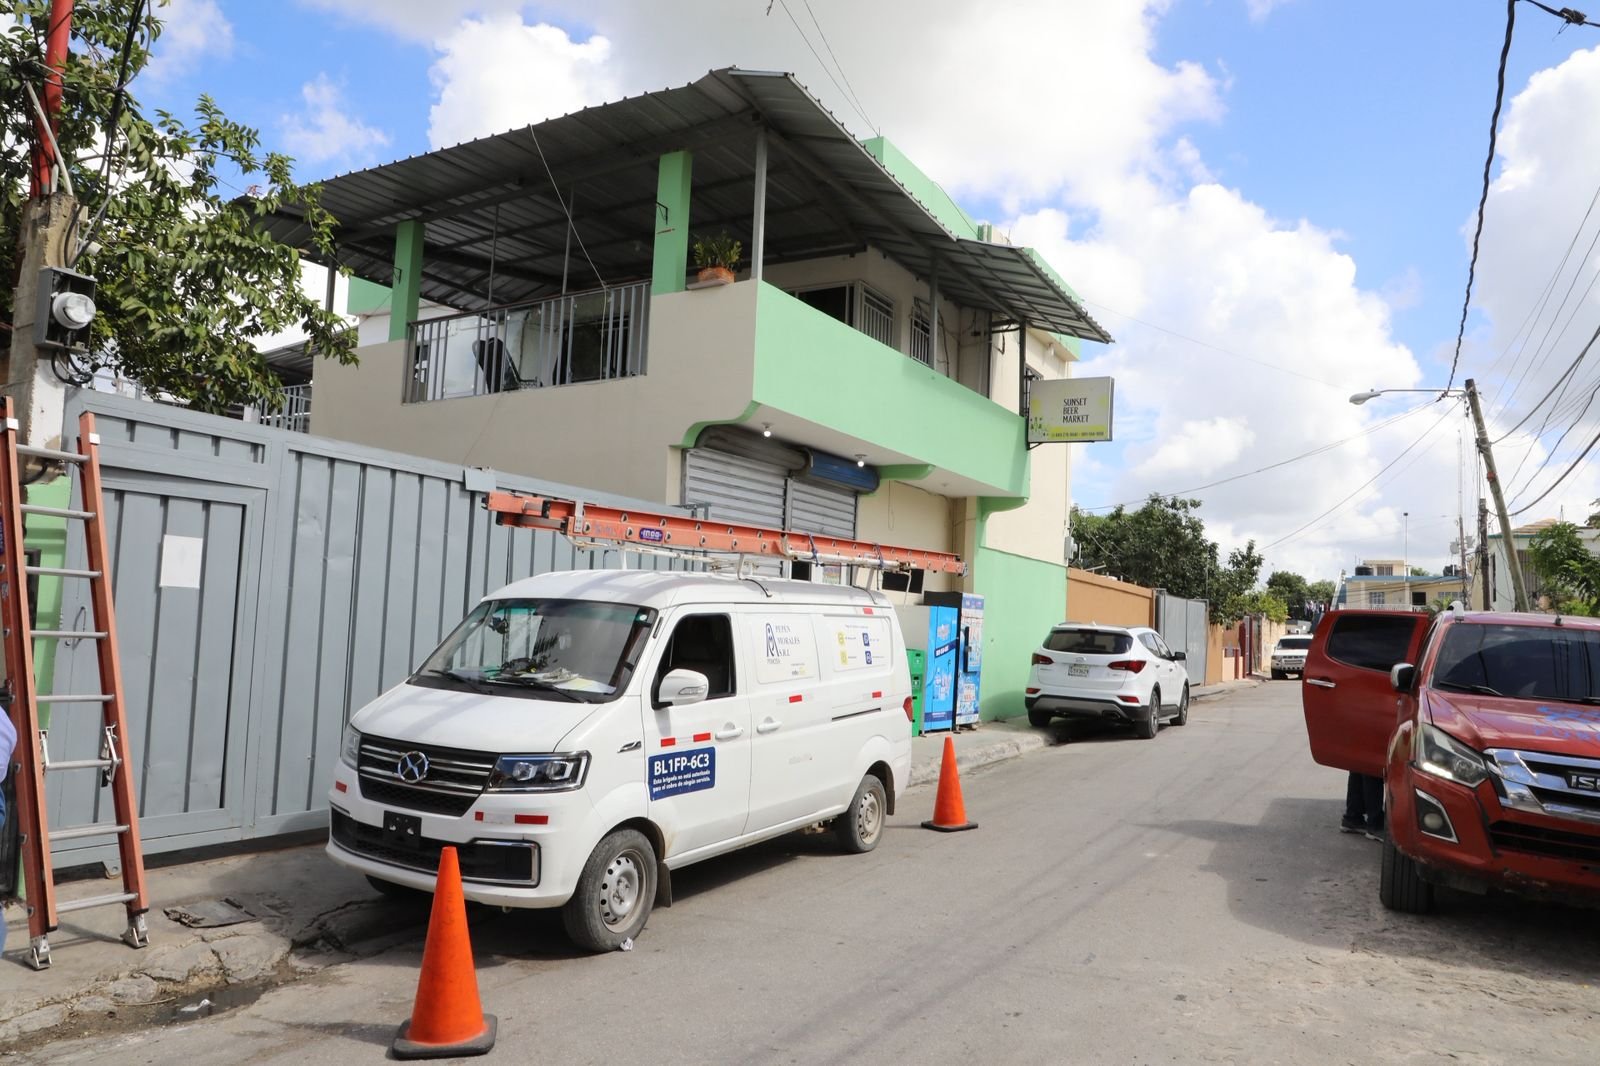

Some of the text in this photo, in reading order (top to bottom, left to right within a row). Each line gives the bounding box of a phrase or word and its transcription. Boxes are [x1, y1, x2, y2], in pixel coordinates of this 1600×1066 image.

[1063, 398, 1087, 406] SUNSET
[1063, 415, 1089, 423] MARKET
[654, 754, 710, 776] BL1FP-6C3
[662, 775, 677, 783] brigada
[1571, 775, 1600, 791] IS
